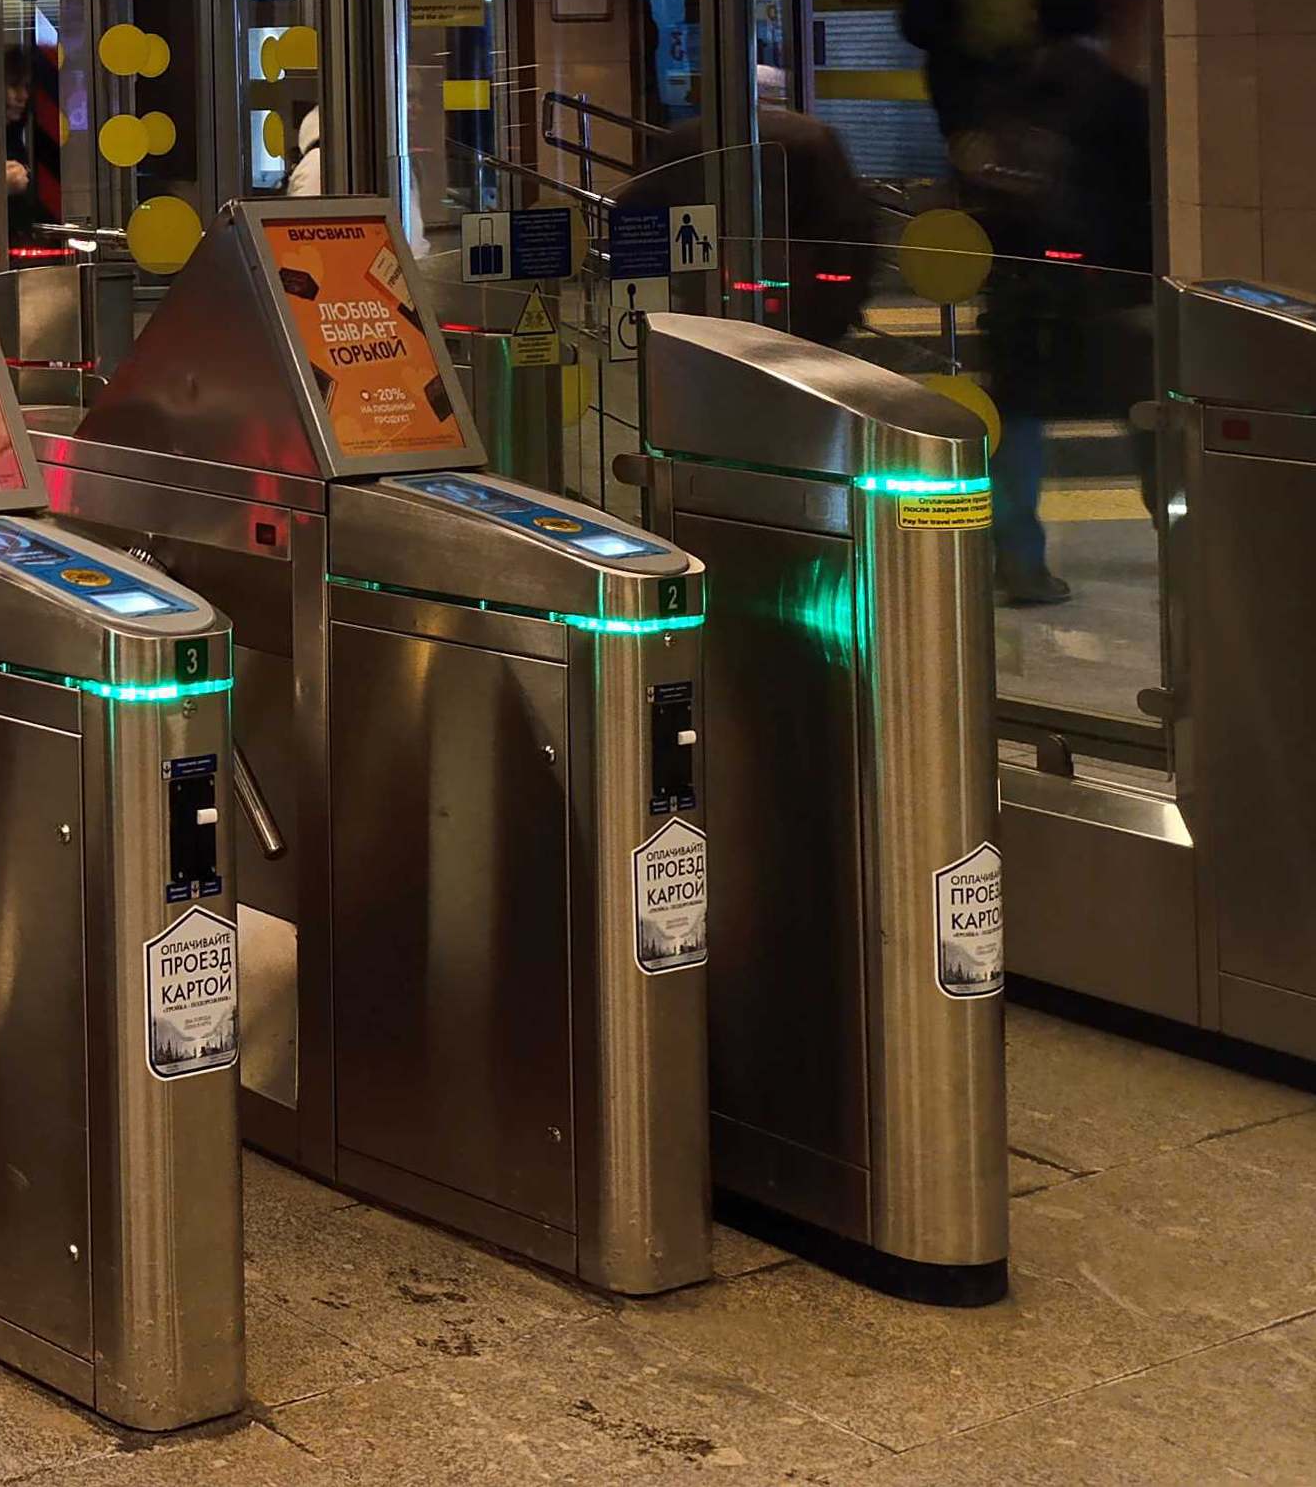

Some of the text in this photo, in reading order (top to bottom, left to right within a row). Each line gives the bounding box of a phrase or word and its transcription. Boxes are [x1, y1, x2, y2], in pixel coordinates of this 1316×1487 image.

[288, 226, 365, 242] ВКУСВИЛЛ
[318, 300, 390, 321] ЛЮБОВЬ
[329, 335, 407, 366] ГОРЬКОЙ
[373, 387, 406, 401] -20%
[668, 586, 678, 609] 2
[186, 647, 198, 674] 3
[646, 841, 704, 862] ОПЛАЧИВАЙТЕ
[646, 855, 704, 882] ПРОЕЗД
[647, 874, 704, 907] КАРТОЙ
[950, 907, 1000, 931] КАРТО
[161, 932, 231, 956] ОПЛАЧИВАЙТЕ
[161, 946, 232, 978] ПРОЕЗД
[161, 968, 231, 1005] КАРТОЙ
